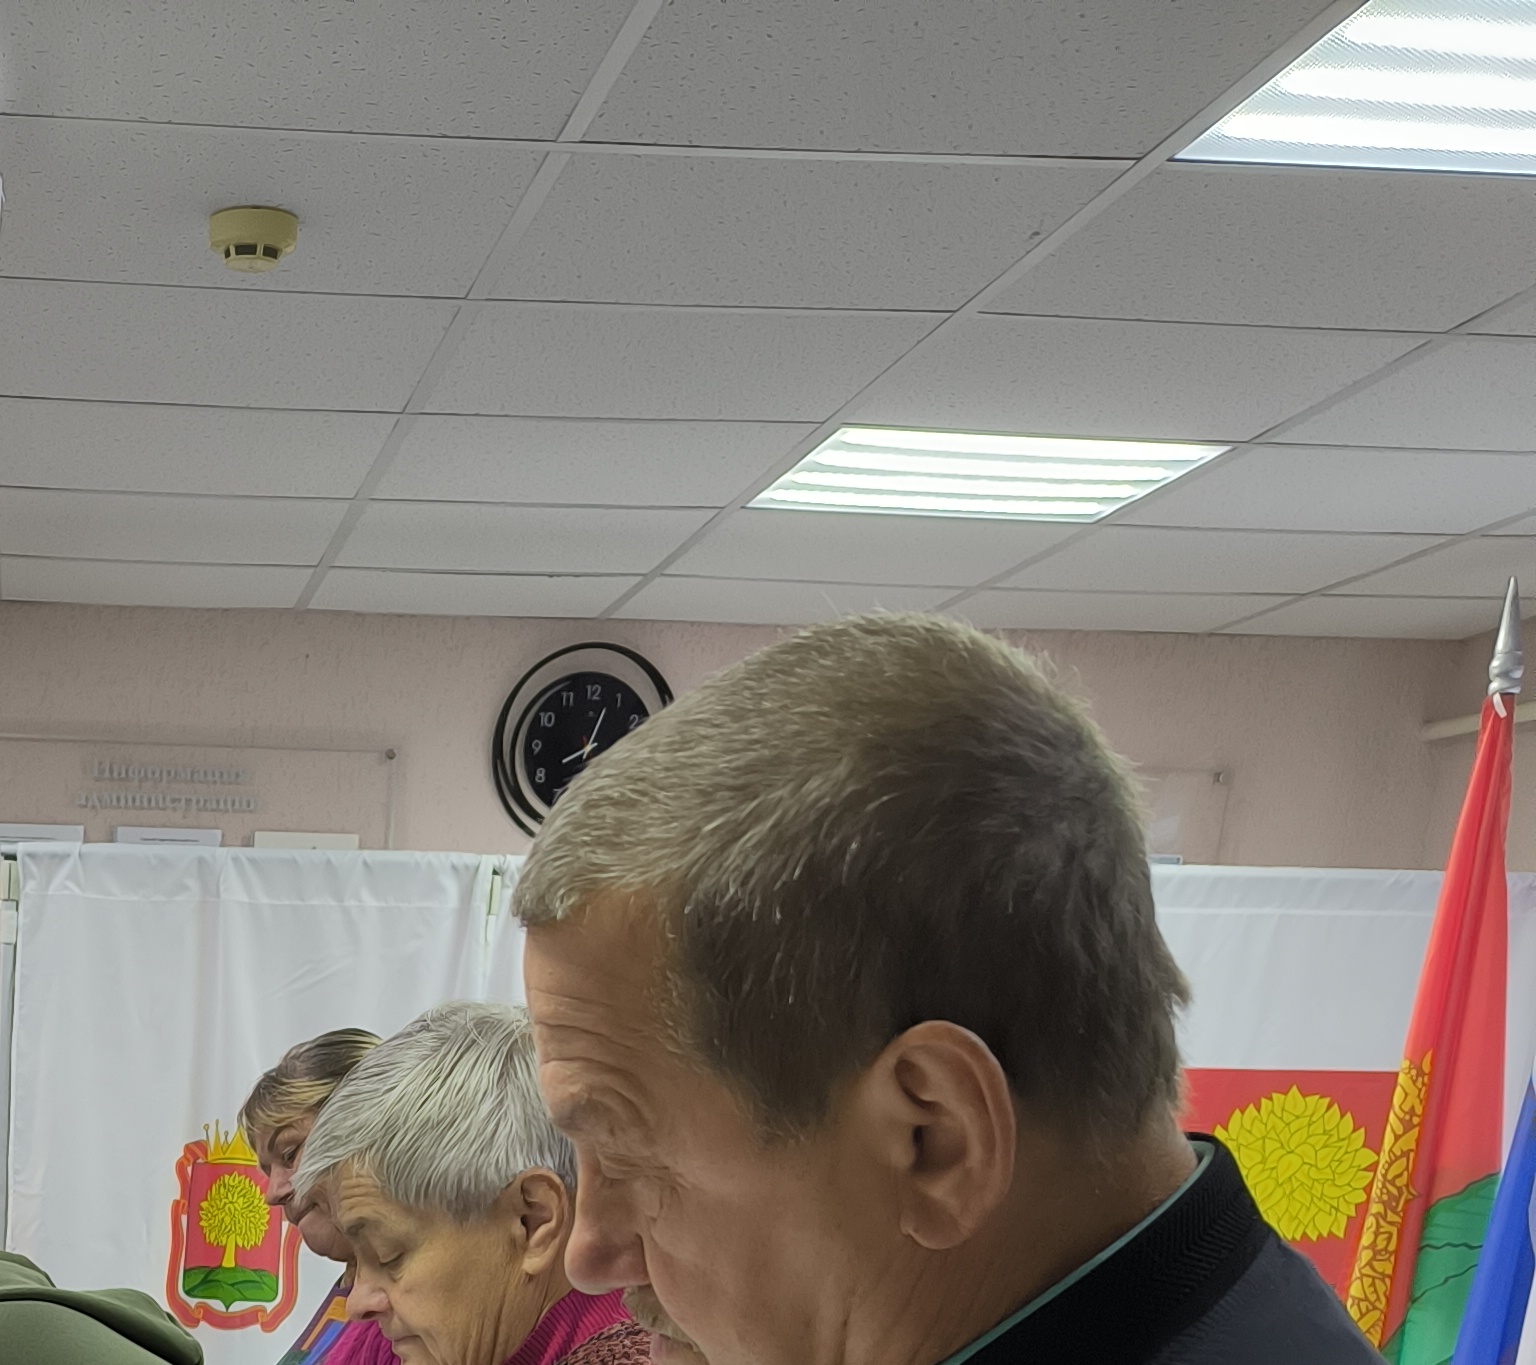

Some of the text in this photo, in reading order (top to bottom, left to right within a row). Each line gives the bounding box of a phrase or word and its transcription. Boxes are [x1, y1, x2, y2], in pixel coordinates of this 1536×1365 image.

[561, 691, 574, 707] 11
[586, 685, 602, 700] 12
[616, 693, 622, 708] 1
[539, 711, 555, 728] 10
[531, 739, 542, 755] 9
[535, 767, 546, 783] 8
